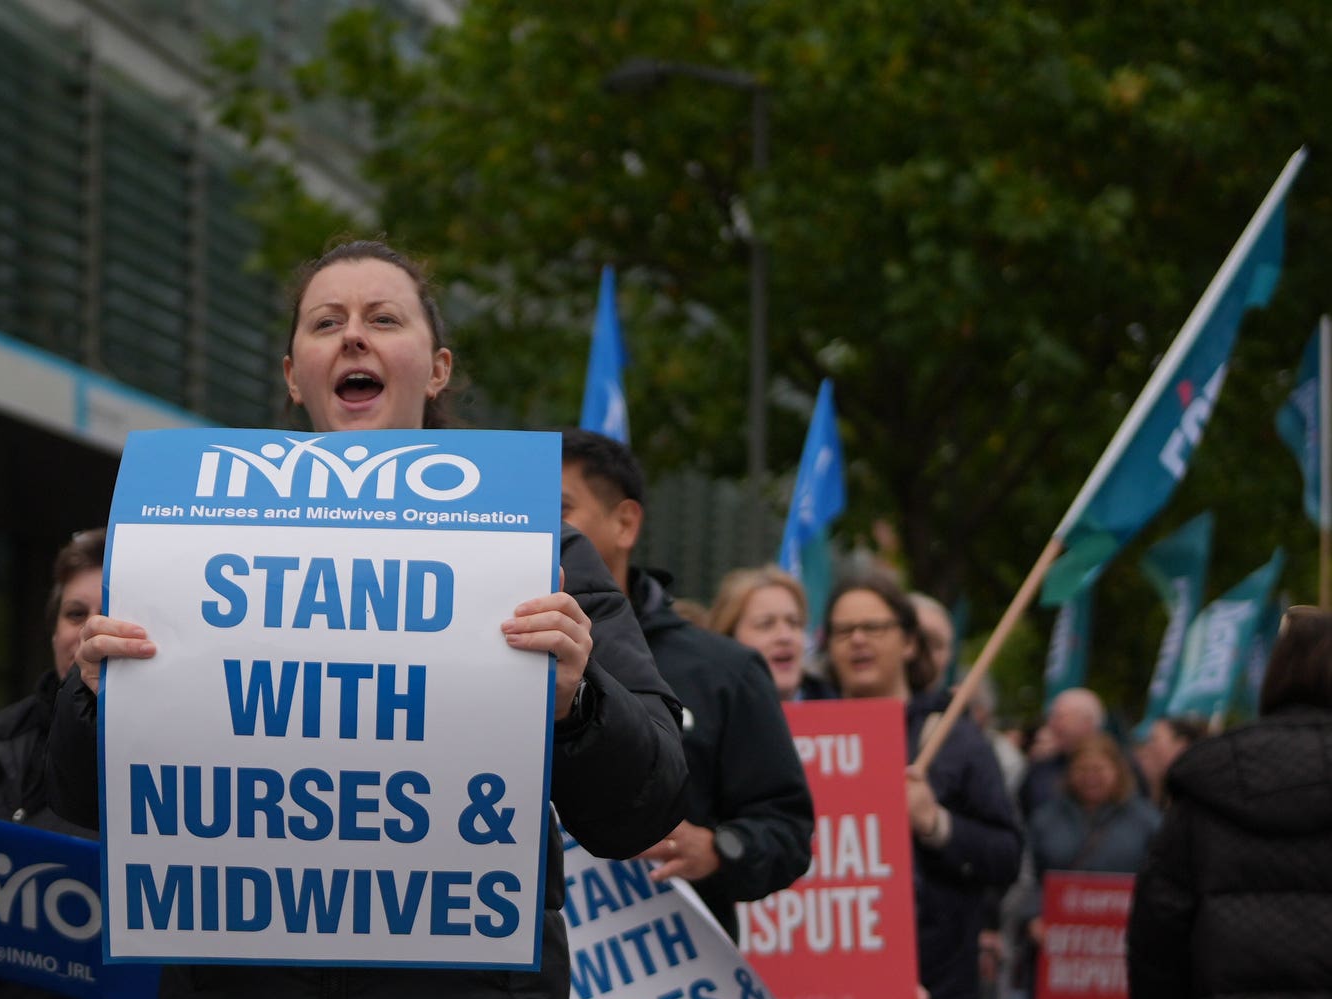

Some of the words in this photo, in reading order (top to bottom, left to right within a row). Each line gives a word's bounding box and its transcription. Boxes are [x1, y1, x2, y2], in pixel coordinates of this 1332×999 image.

[195, 437, 481, 501] INMO
[141, 504, 184, 517] Irish
[189, 505, 259, 519] Nurses
[263, 506, 301, 519] and
[305, 506, 397, 521] Midwives
[402, 508, 529, 525] Organisation
[201, 553, 455, 633] STAND
[223, 659, 427, 742] WITH
[794, 733, 863, 776] PTU
[129, 763, 431, 843] NURSES
[457, 772, 517, 846] &
[125, 863, 522, 939] MIDWIVES
[738, 885, 885, 955] ISPUTE
